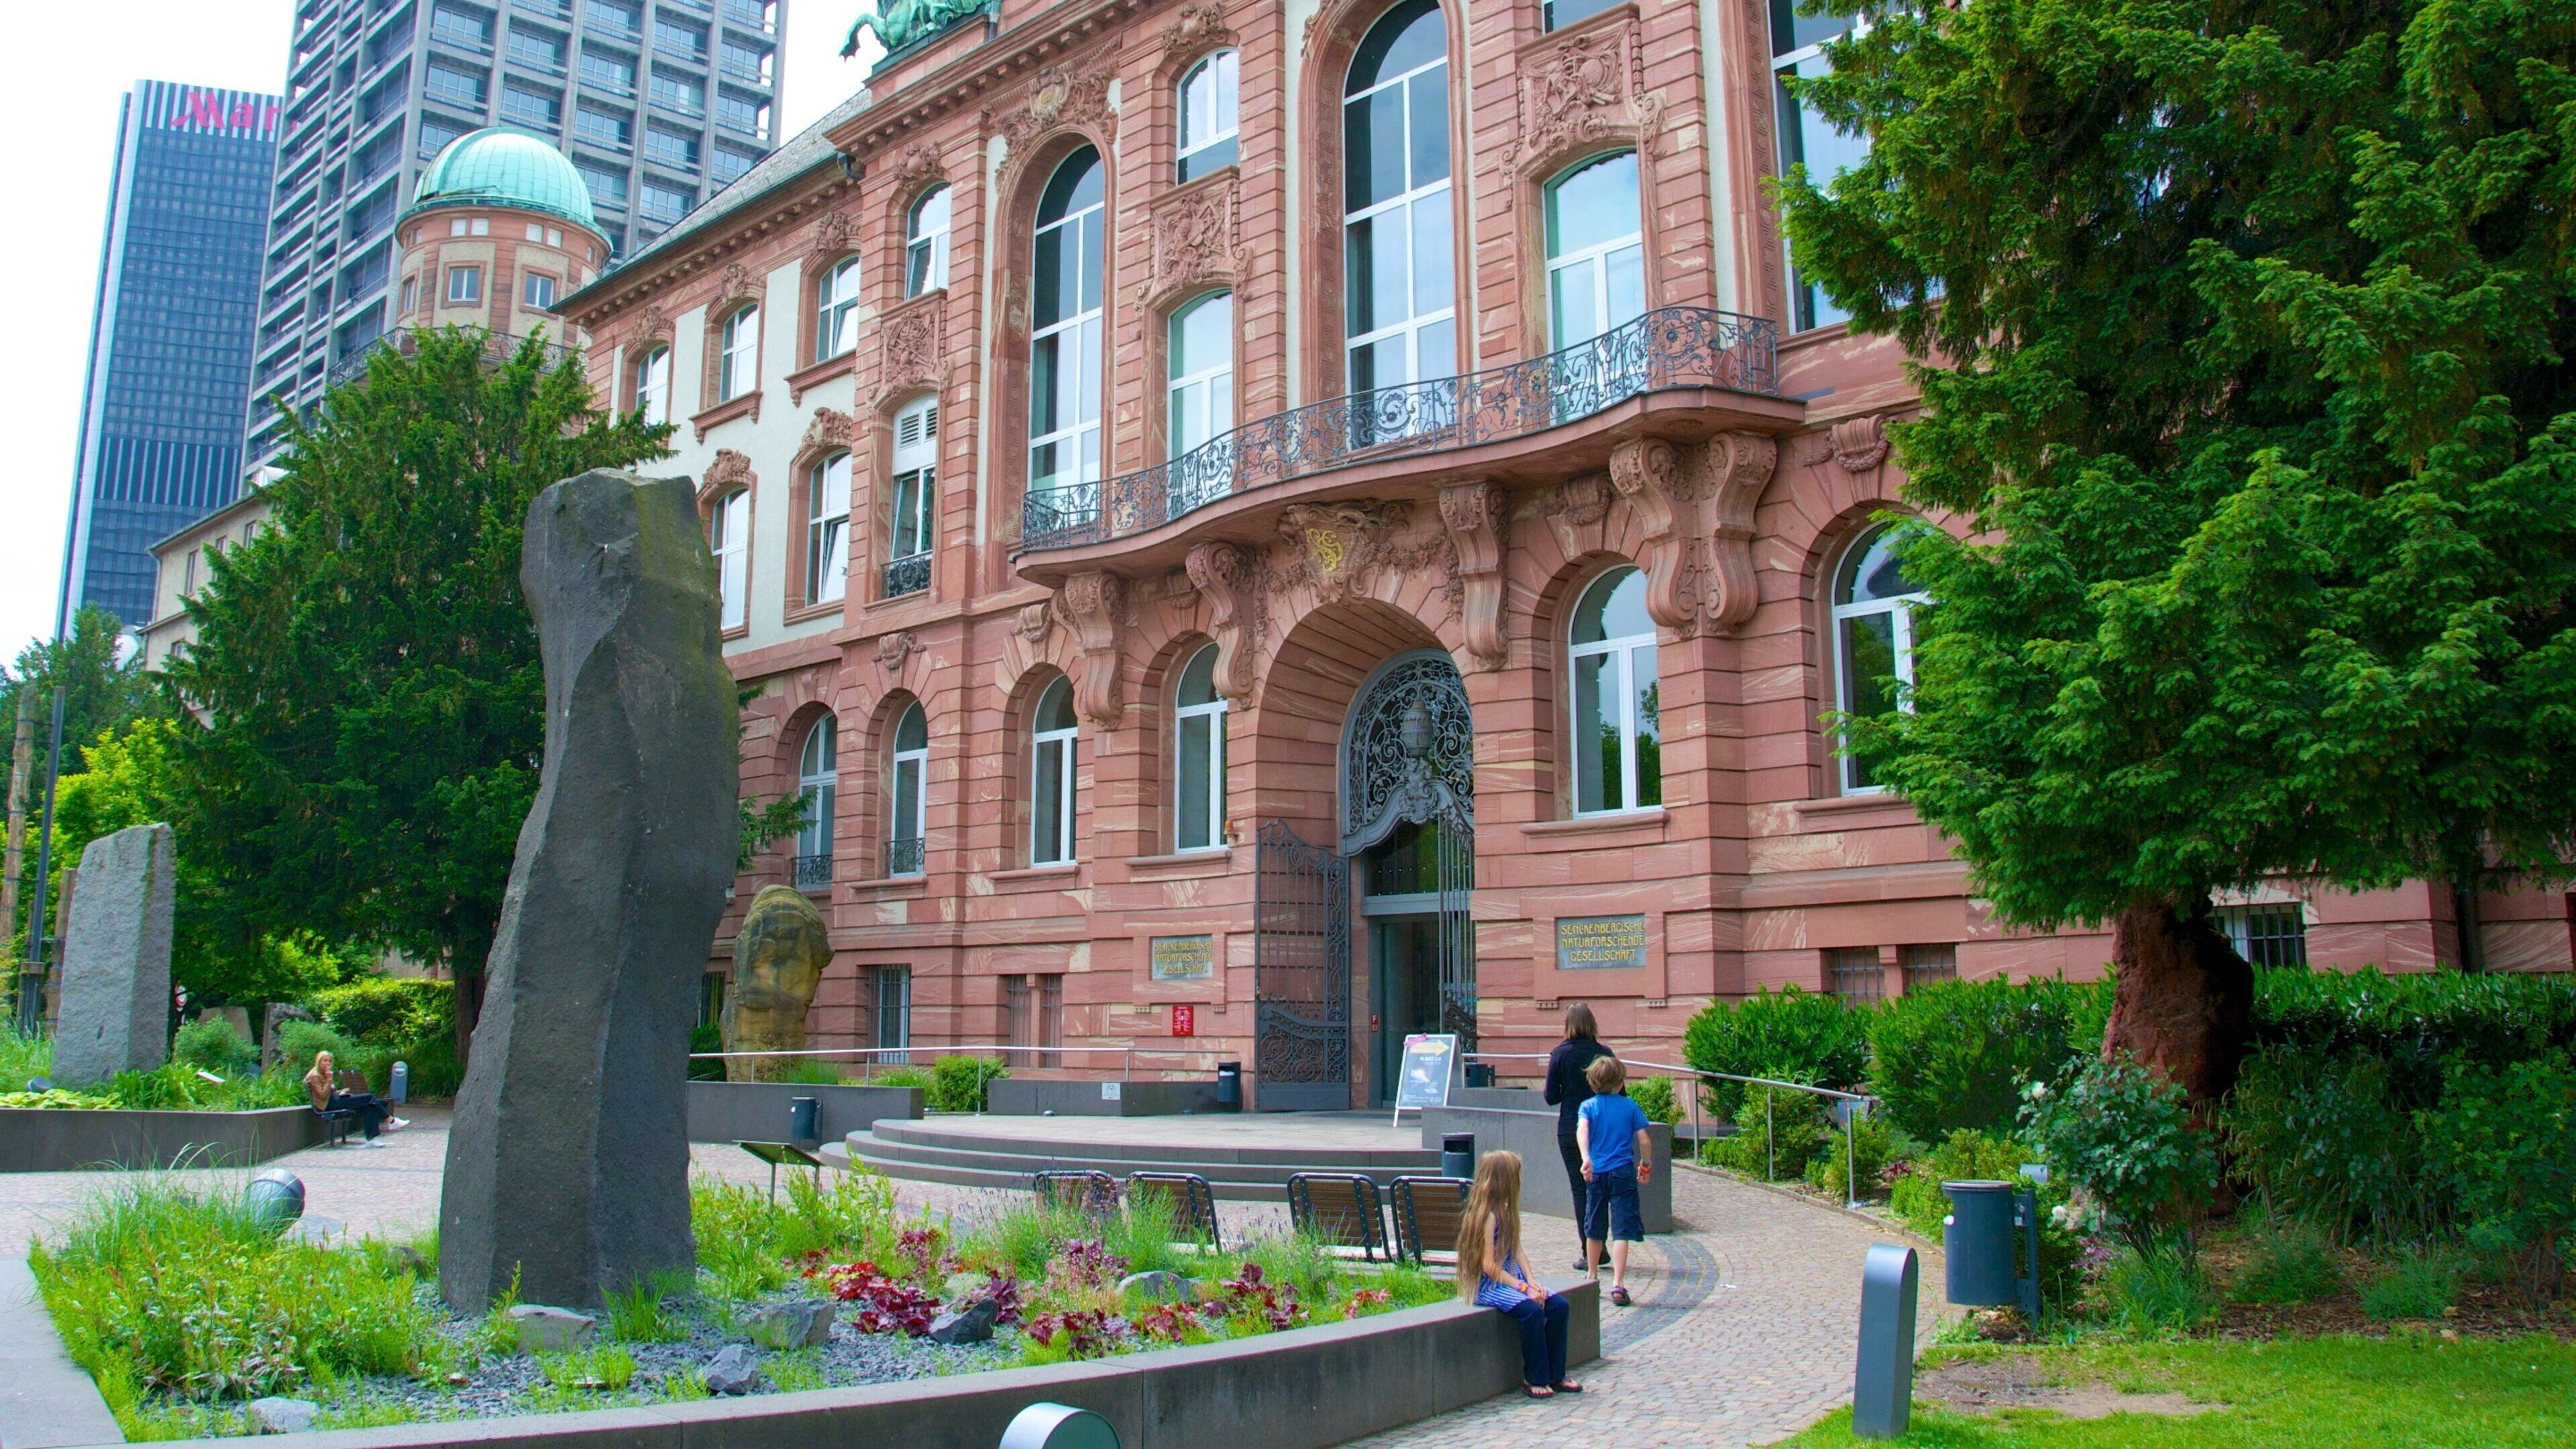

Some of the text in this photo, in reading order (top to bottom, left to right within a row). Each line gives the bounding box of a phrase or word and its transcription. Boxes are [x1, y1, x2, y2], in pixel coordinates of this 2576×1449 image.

[1561, 922, 1644, 935] SENCKENBERGISCHE
[1562, 935, 1644, 947] NATURFORSCHENDE
[1570, 949, 1636, 961] GESELLSCHAFT
